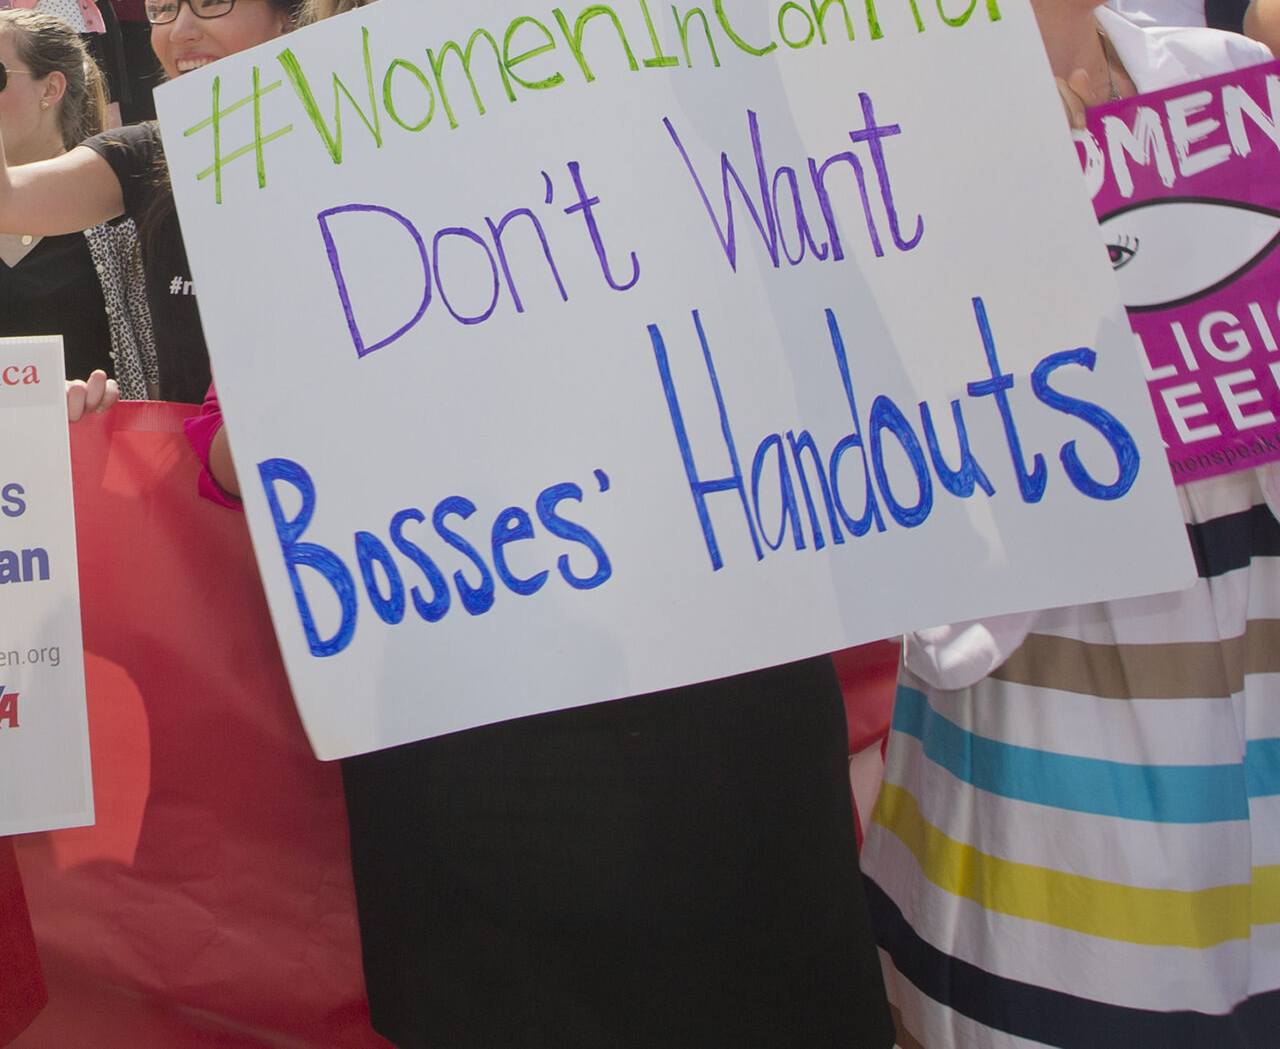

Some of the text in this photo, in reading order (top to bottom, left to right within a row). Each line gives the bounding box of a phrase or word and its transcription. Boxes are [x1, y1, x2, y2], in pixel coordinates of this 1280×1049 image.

[318, 92, 923, 358] Don't Want
[1071, 74, 1280, 199] OMEN
[258, 296, 1140, 658] Bosses' Handouts
